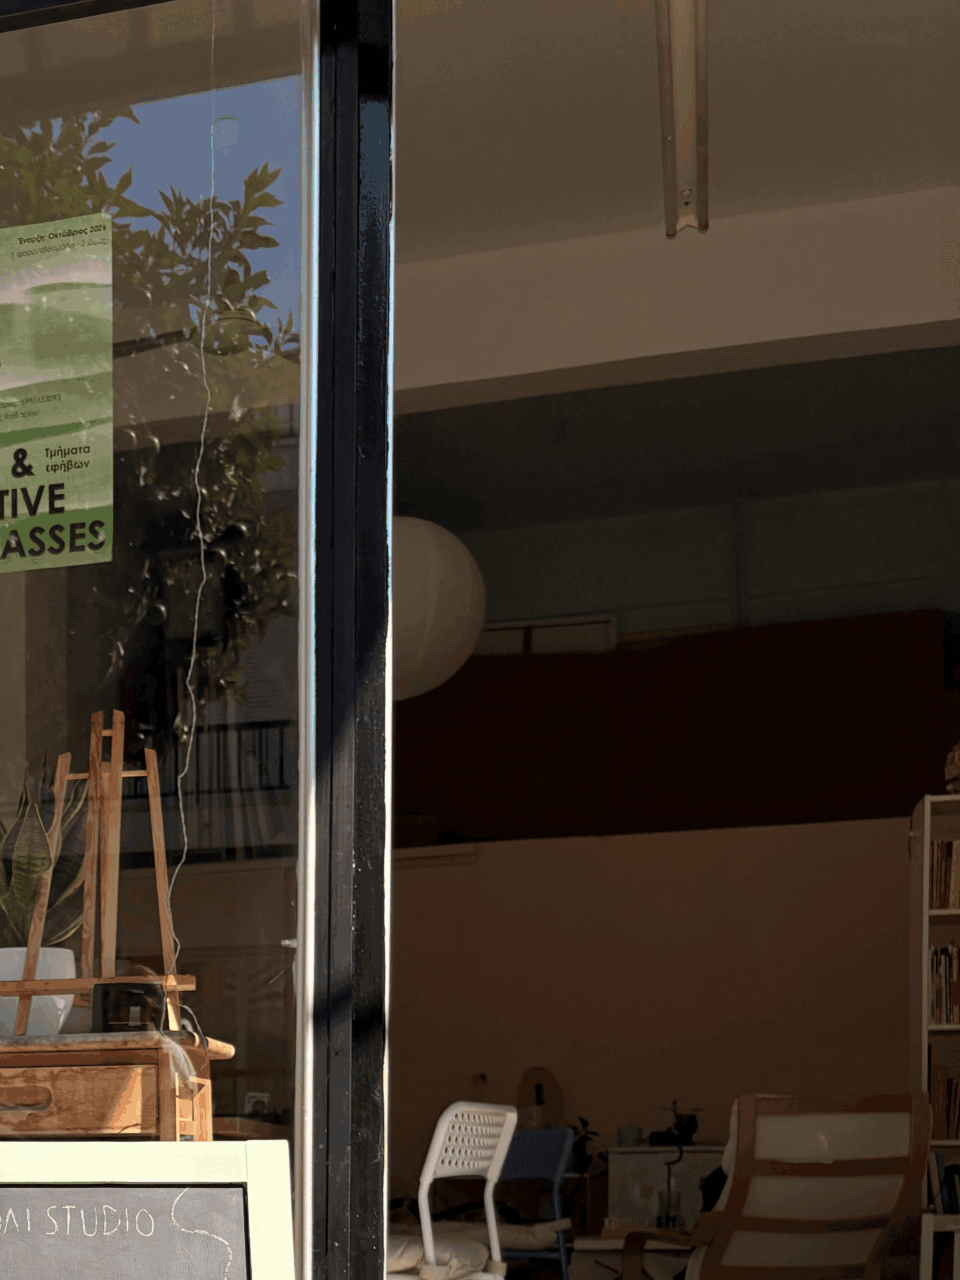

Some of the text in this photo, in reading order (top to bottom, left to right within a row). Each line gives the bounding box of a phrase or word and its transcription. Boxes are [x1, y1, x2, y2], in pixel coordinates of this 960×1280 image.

[11, 448, 35, 478] &
[45, 445, 91, 459] Τμήματα
[45, 459, 91, 474] εφήβων
[46, 1204, 155, 1237] STUDIO
